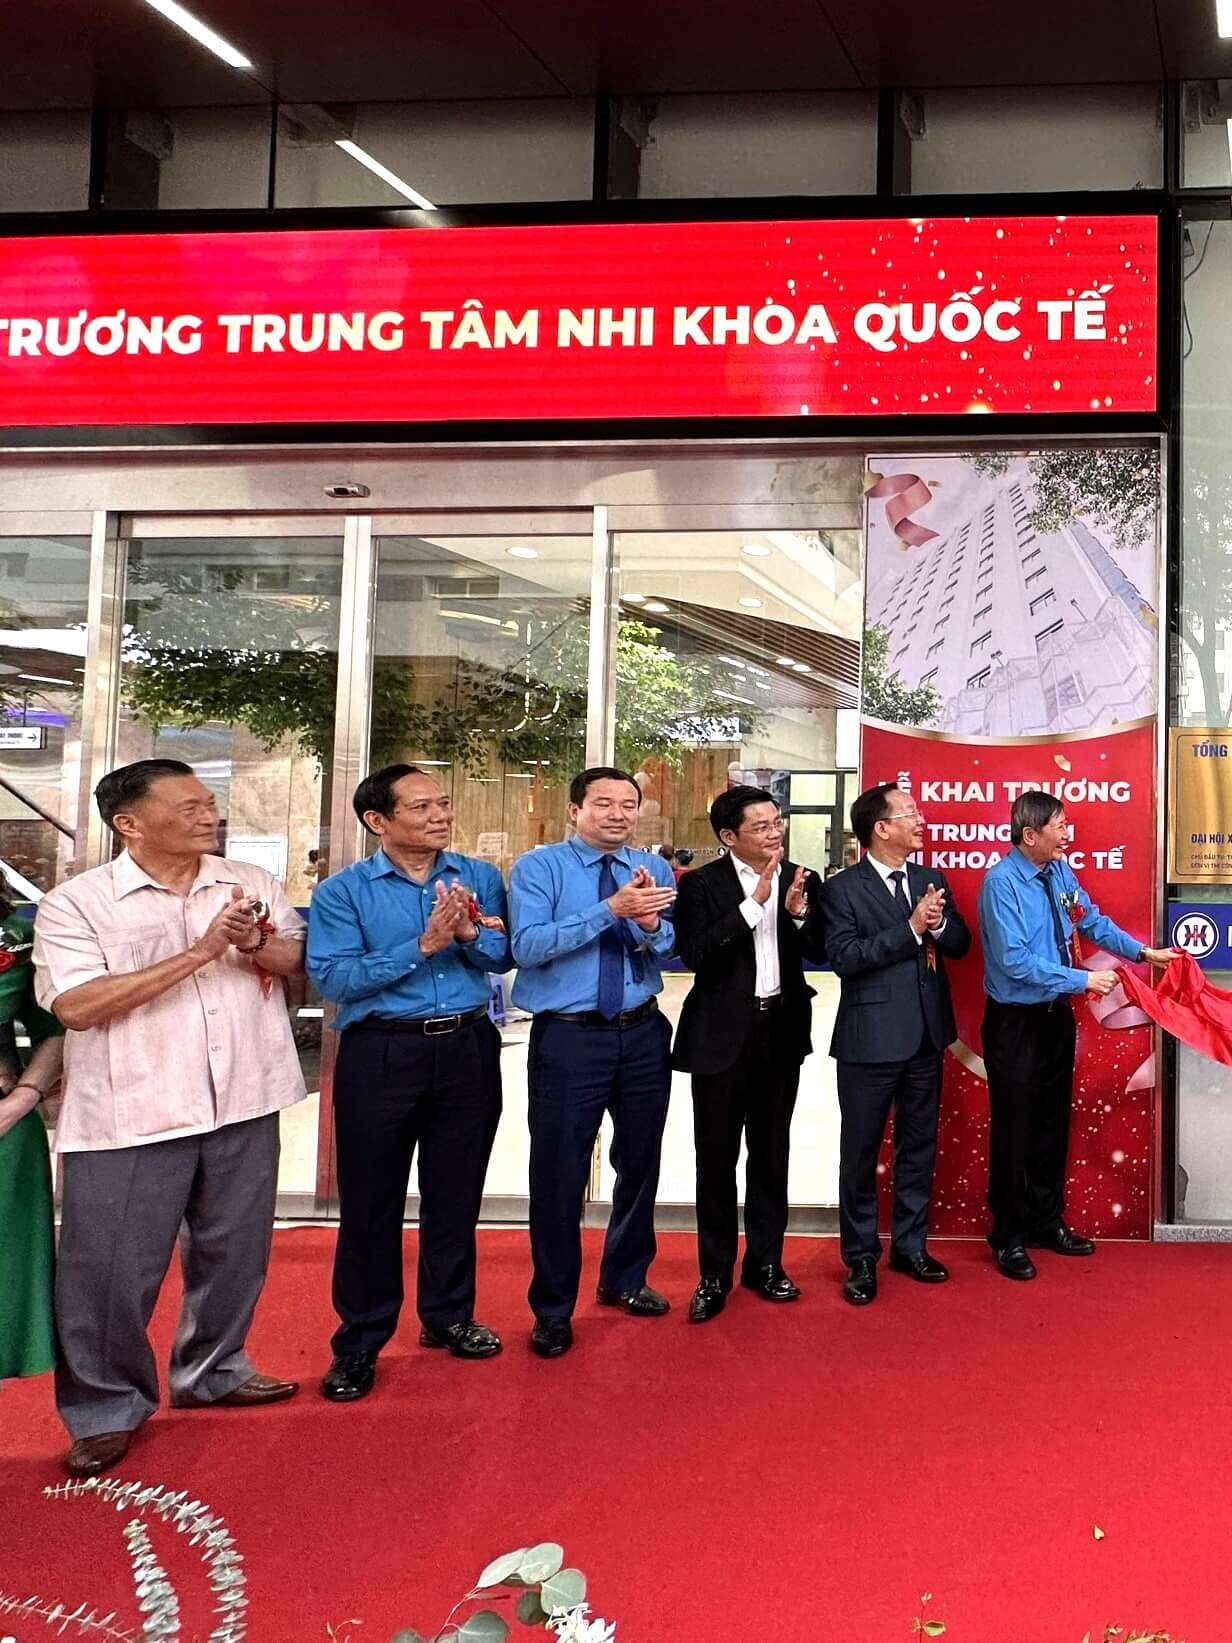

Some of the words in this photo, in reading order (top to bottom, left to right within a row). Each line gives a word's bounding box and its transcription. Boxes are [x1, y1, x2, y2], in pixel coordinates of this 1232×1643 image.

[219, 312, 404, 352] TRUNG
[421, 299, 539, 350] TÂM
[558, 307, 654, 347] NHI
[673, 304, 838, 346] KHOA
[854, 286, 1021, 352] QUỐC
[1038, 284, 1114, 341] TẾ
[1192, 740, 1228, 758] TỔNG
[921, 782, 994, 802] KHAI
[927, 824, 1012, 842] TRUNG
[1092, 845, 1126, 869] TẾ
